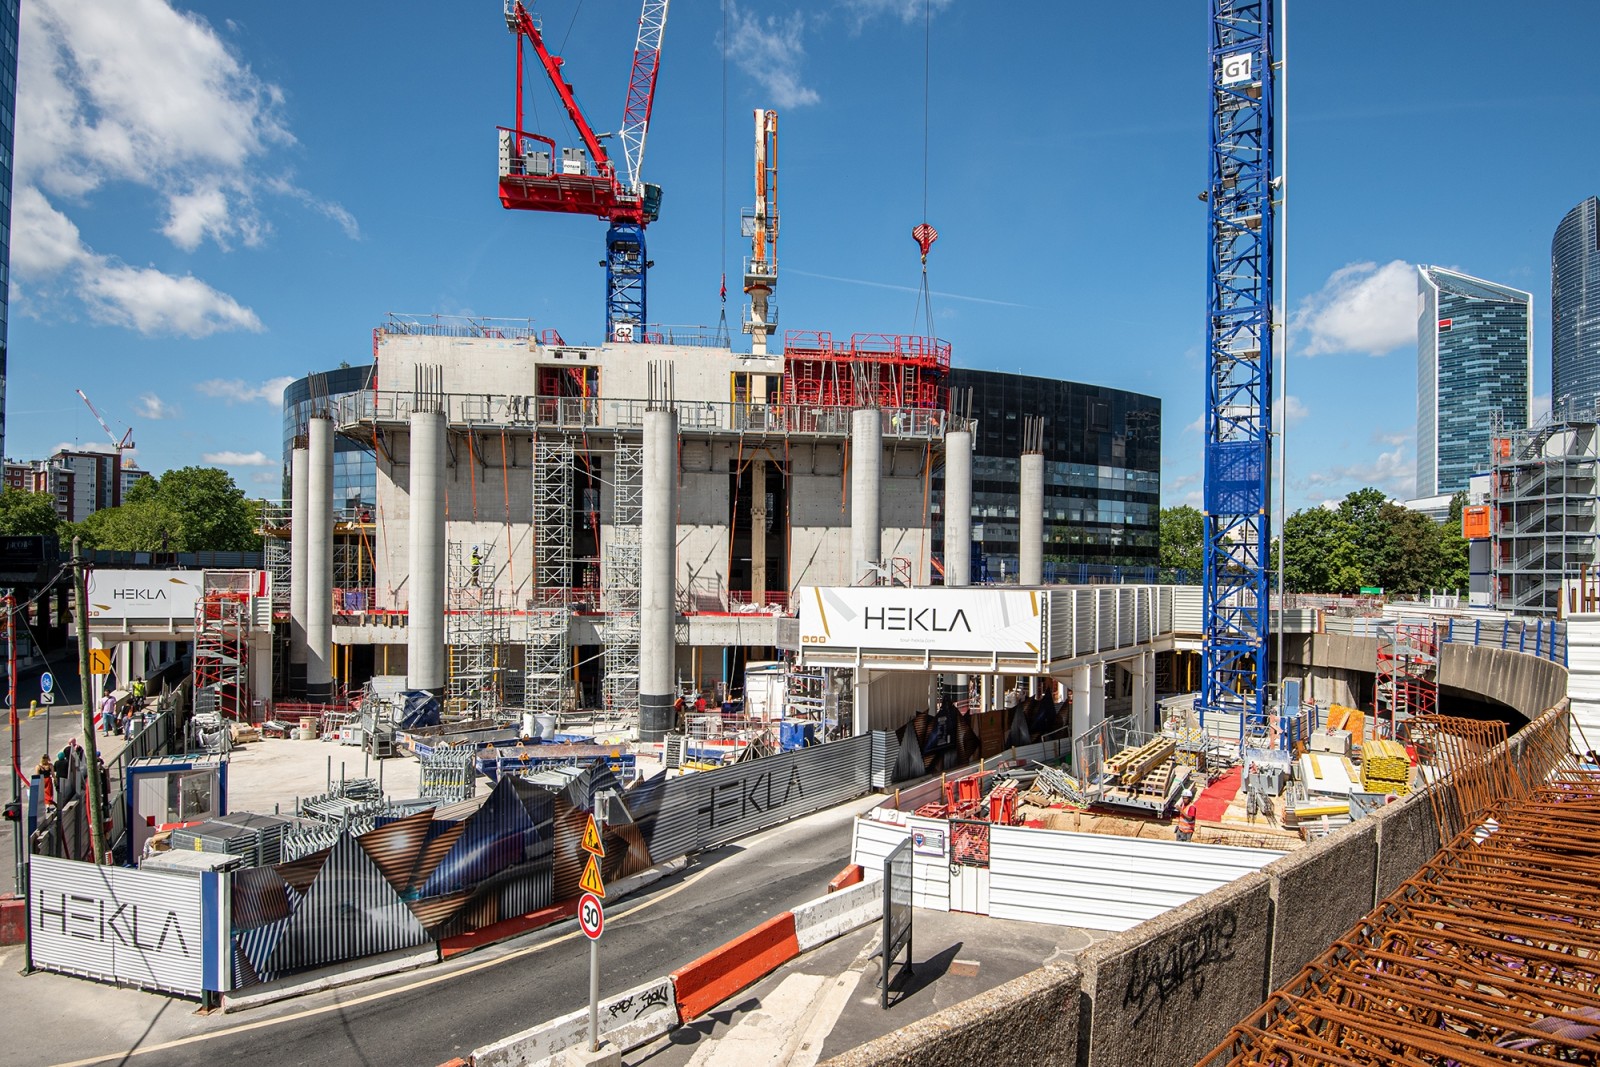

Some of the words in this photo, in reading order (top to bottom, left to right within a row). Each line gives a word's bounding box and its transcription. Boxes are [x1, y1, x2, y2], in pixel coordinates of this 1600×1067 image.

[1225, 58, 1249, 78] G1
[616, 327, 632, 338] G2
[114, 589, 167, 599] HEKLA
[864, 606, 972, 633] HEKLA
[40, 889, 190, 958] HEKLA
[584, 904, 599, 928] 30
